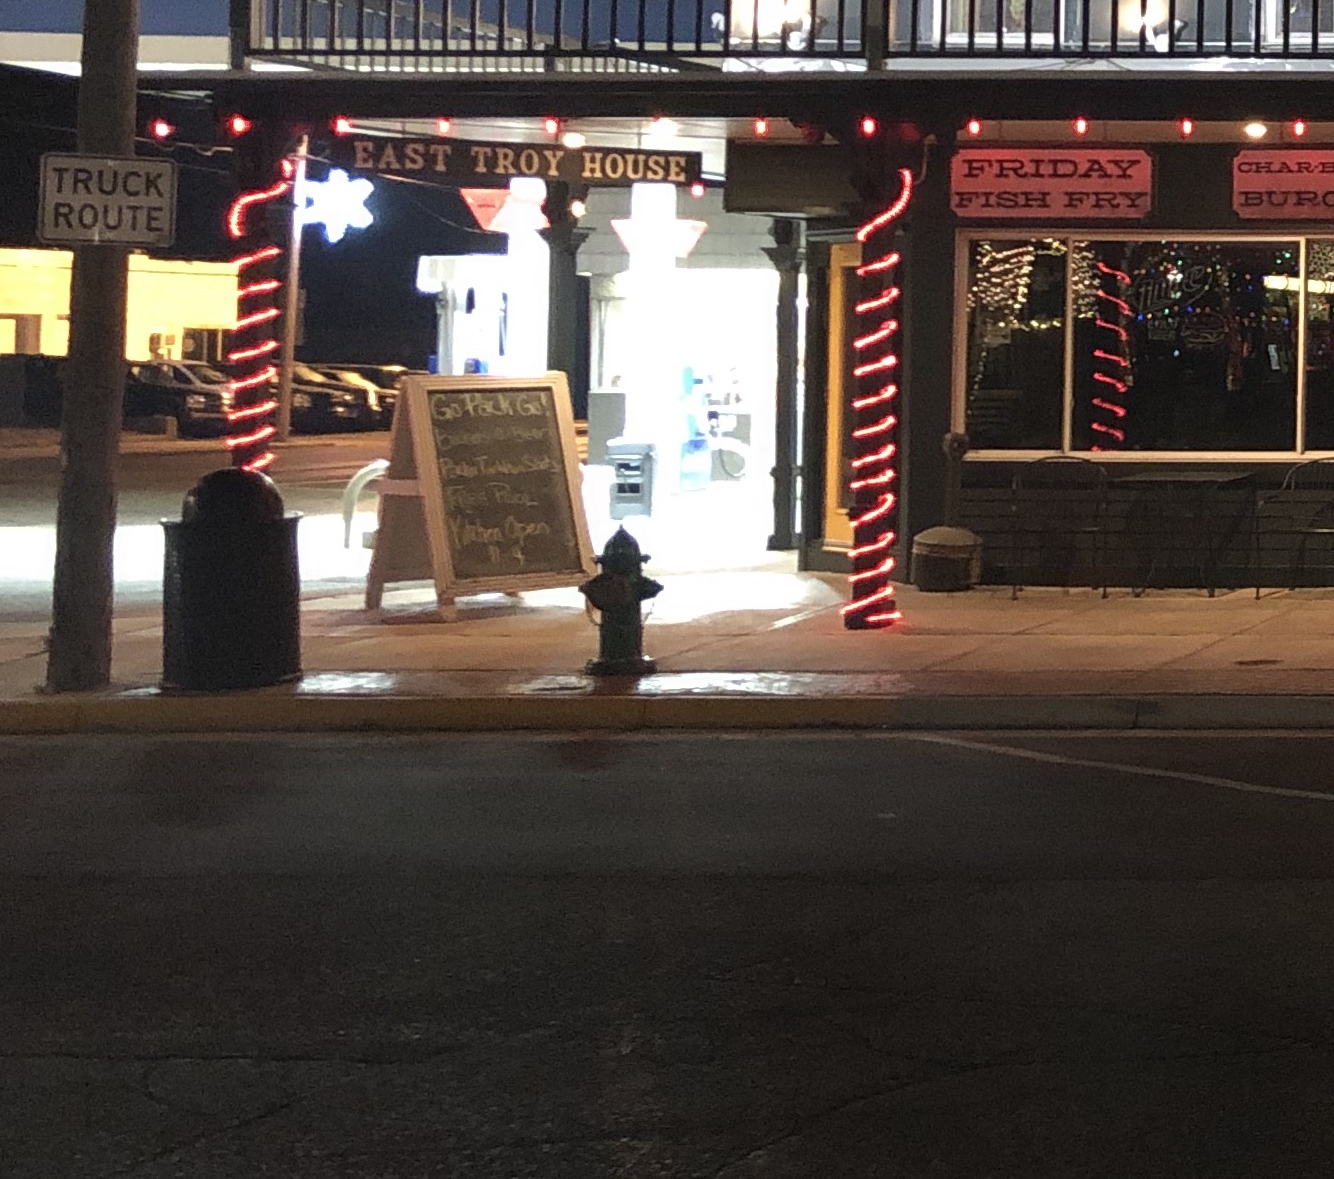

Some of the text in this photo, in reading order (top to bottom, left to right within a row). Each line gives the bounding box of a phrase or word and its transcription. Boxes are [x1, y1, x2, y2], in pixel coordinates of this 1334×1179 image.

[353, 141, 688, 182] EAST TROY HOUSE
[961, 159, 1142, 179] FRIDAY
[52, 167, 164, 197] TRUCK
[954, 191, 1149, 209] FISH FRY
[53, 201, 164, 232] ROUTE
